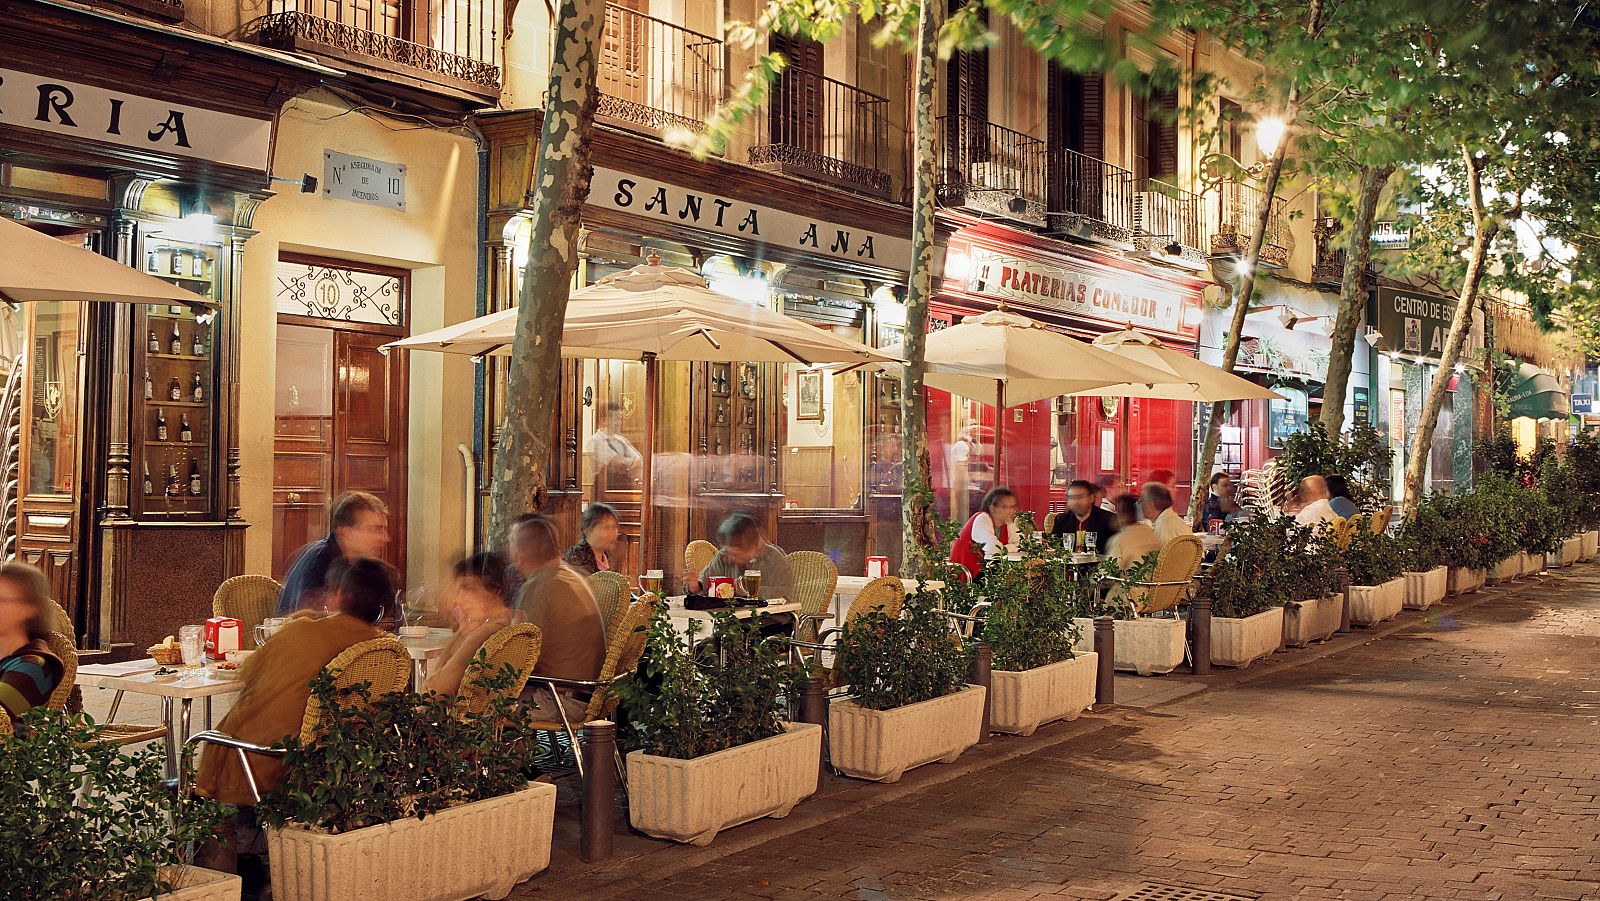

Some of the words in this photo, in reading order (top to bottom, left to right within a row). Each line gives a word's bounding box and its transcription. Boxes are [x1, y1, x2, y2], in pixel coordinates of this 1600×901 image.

[0, 76, 193, 149] RIA
[361, 176, 370, 185] DE
[388, 177, 400, 195] 10
[614, 178, 760, 236] SANTA
[799, 223, 876, 260] ANA
[319, 283, 337, 306] 10
[1000, 265, 1087, 303] PLATERIAS
[1093, 287, 1157, 319] COMEDOR
[1393, 295, 1428, 317] CENTRO
[1430, 301, 1441, 320] DE
[1573, 398, 1591, 406] TAXI
